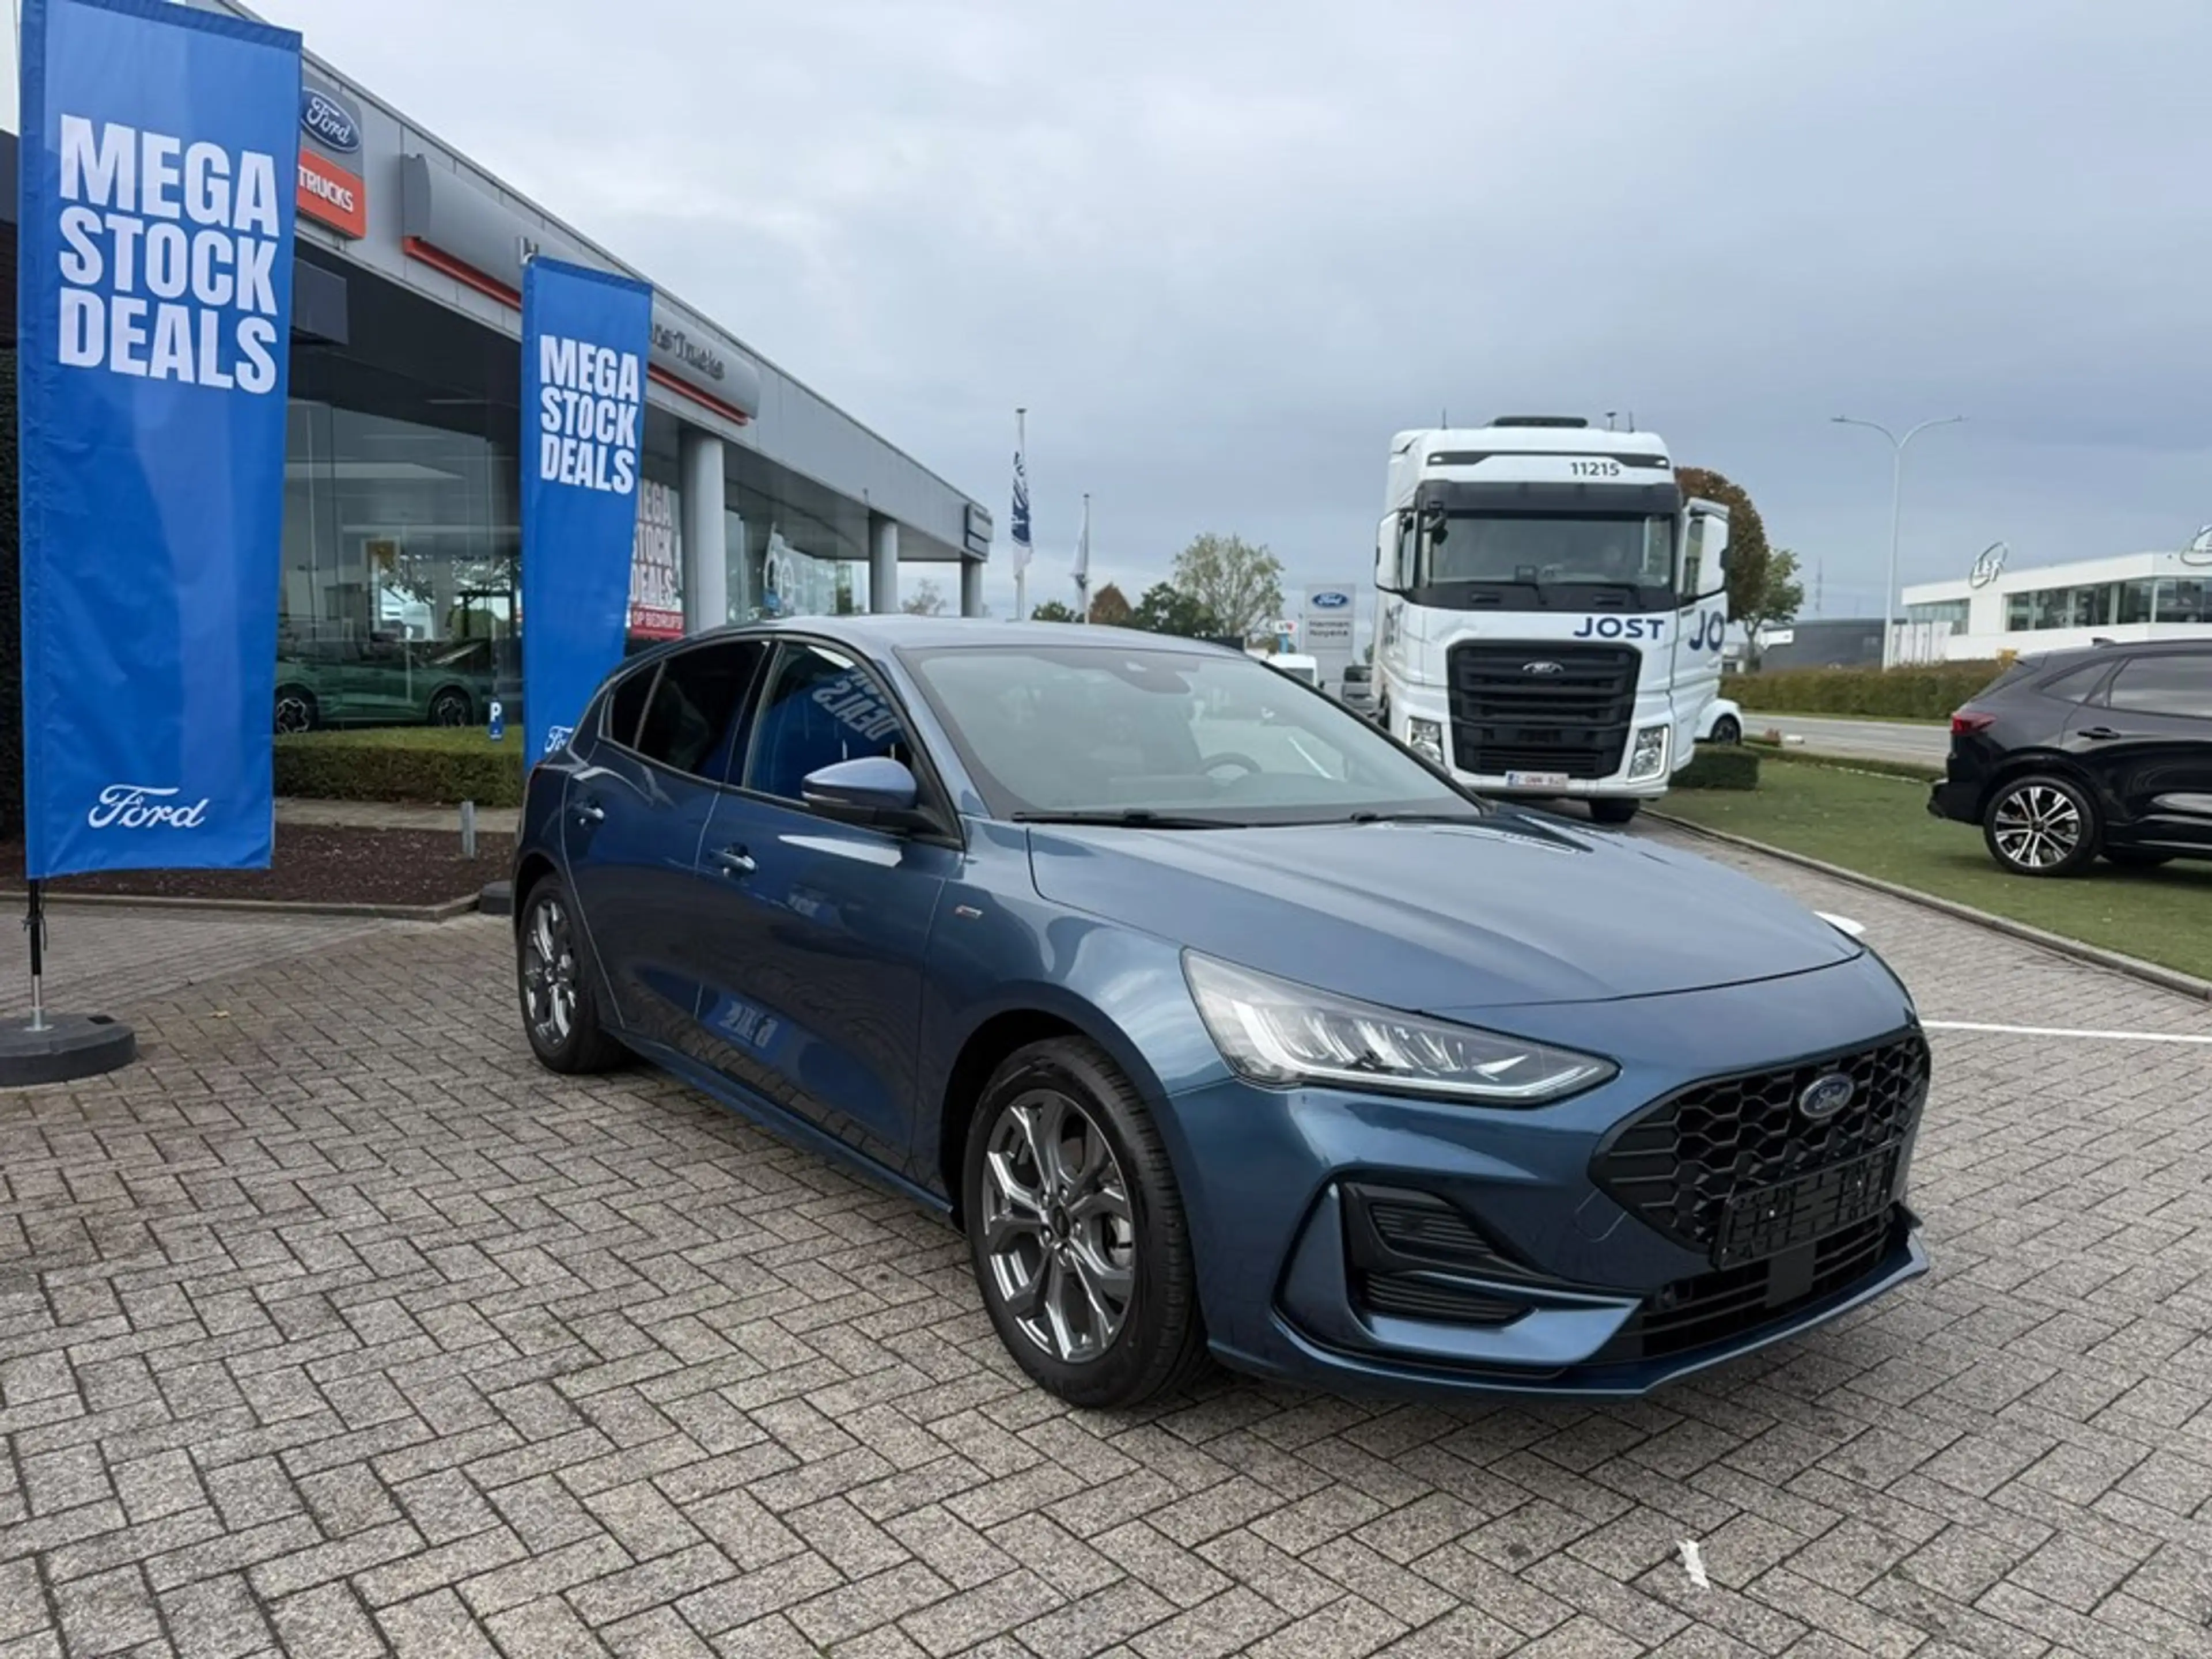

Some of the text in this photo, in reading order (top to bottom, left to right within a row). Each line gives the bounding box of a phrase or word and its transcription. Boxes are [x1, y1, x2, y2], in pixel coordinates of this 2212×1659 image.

[306, 96, 351, 144] Ford
[60, 113, 279, 237] MEGA
[298, 165, 354, 212] TRUCKS
[59, 206, 278, 316] STOCK
[59, 286, 277, 394] DEALS
[540, 335, 639, 403] MEGA
[540, 387, 638, 448] STOCK
[540, 433, 635, 494] DEALS
[1570, 461, 1620, 476] 11215
[633, 521, 673, 568] TOCK
[1573, 617, 1664, 639] JOST
[490, 702, 502, 722] P
[88, 784, 209, 827] Ford
